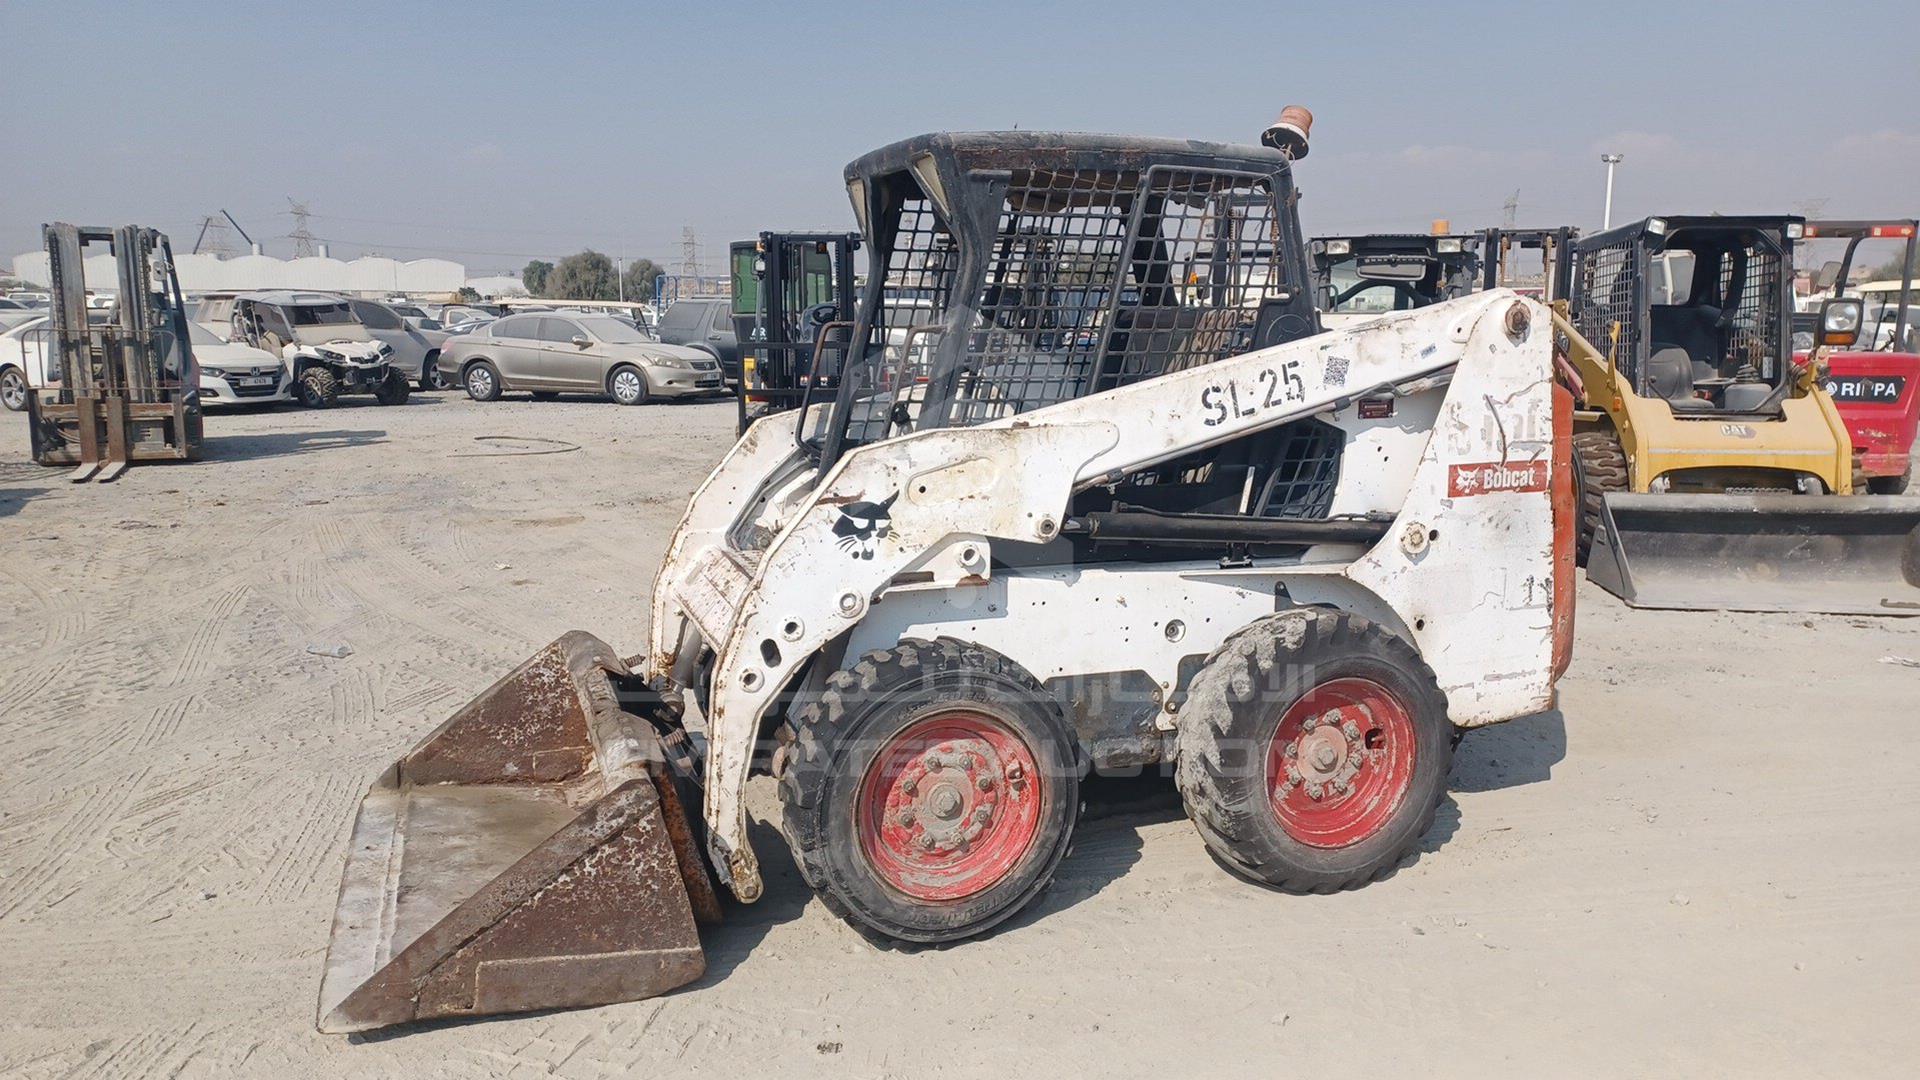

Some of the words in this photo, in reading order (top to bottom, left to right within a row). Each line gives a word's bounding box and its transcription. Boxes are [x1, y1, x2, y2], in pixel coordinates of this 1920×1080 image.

[1201, 360, 1306, 427] SL25
[1840, 382, 1897, 397] RIPA
[1721, 424, 1748, 437] CAT
[1482, 466, 1536, 490] Bobcat
